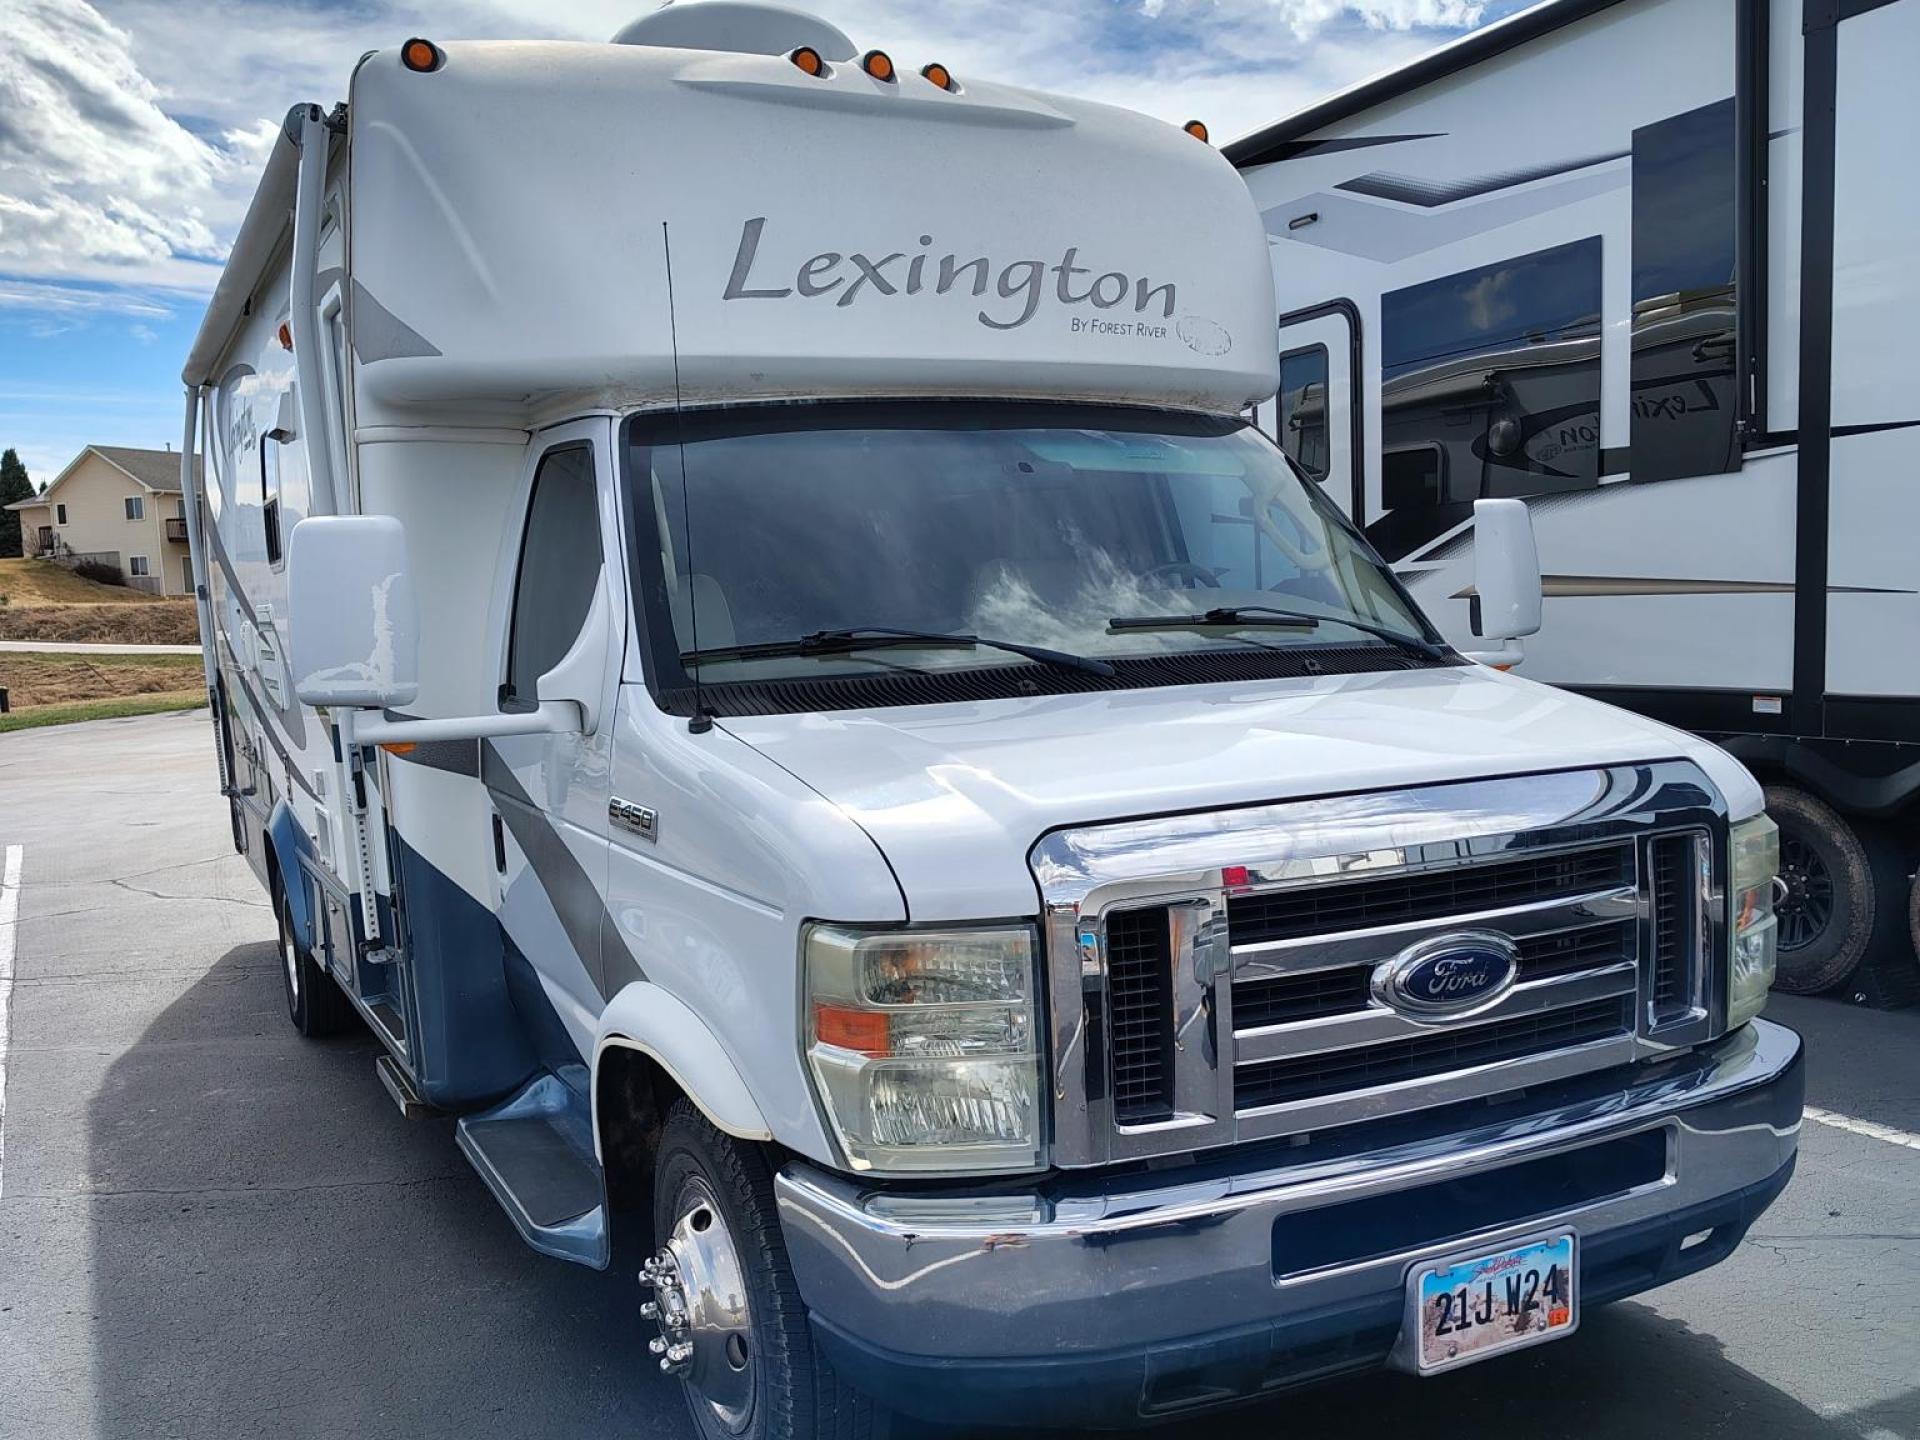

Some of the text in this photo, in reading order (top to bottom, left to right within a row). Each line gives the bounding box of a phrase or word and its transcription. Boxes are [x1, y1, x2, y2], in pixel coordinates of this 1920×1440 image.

[722, 216, 1177, 331] Lexington
[1428, 957, 1489, 994] Ford
[1435, 1264, 1558, 1337] 21J W24
